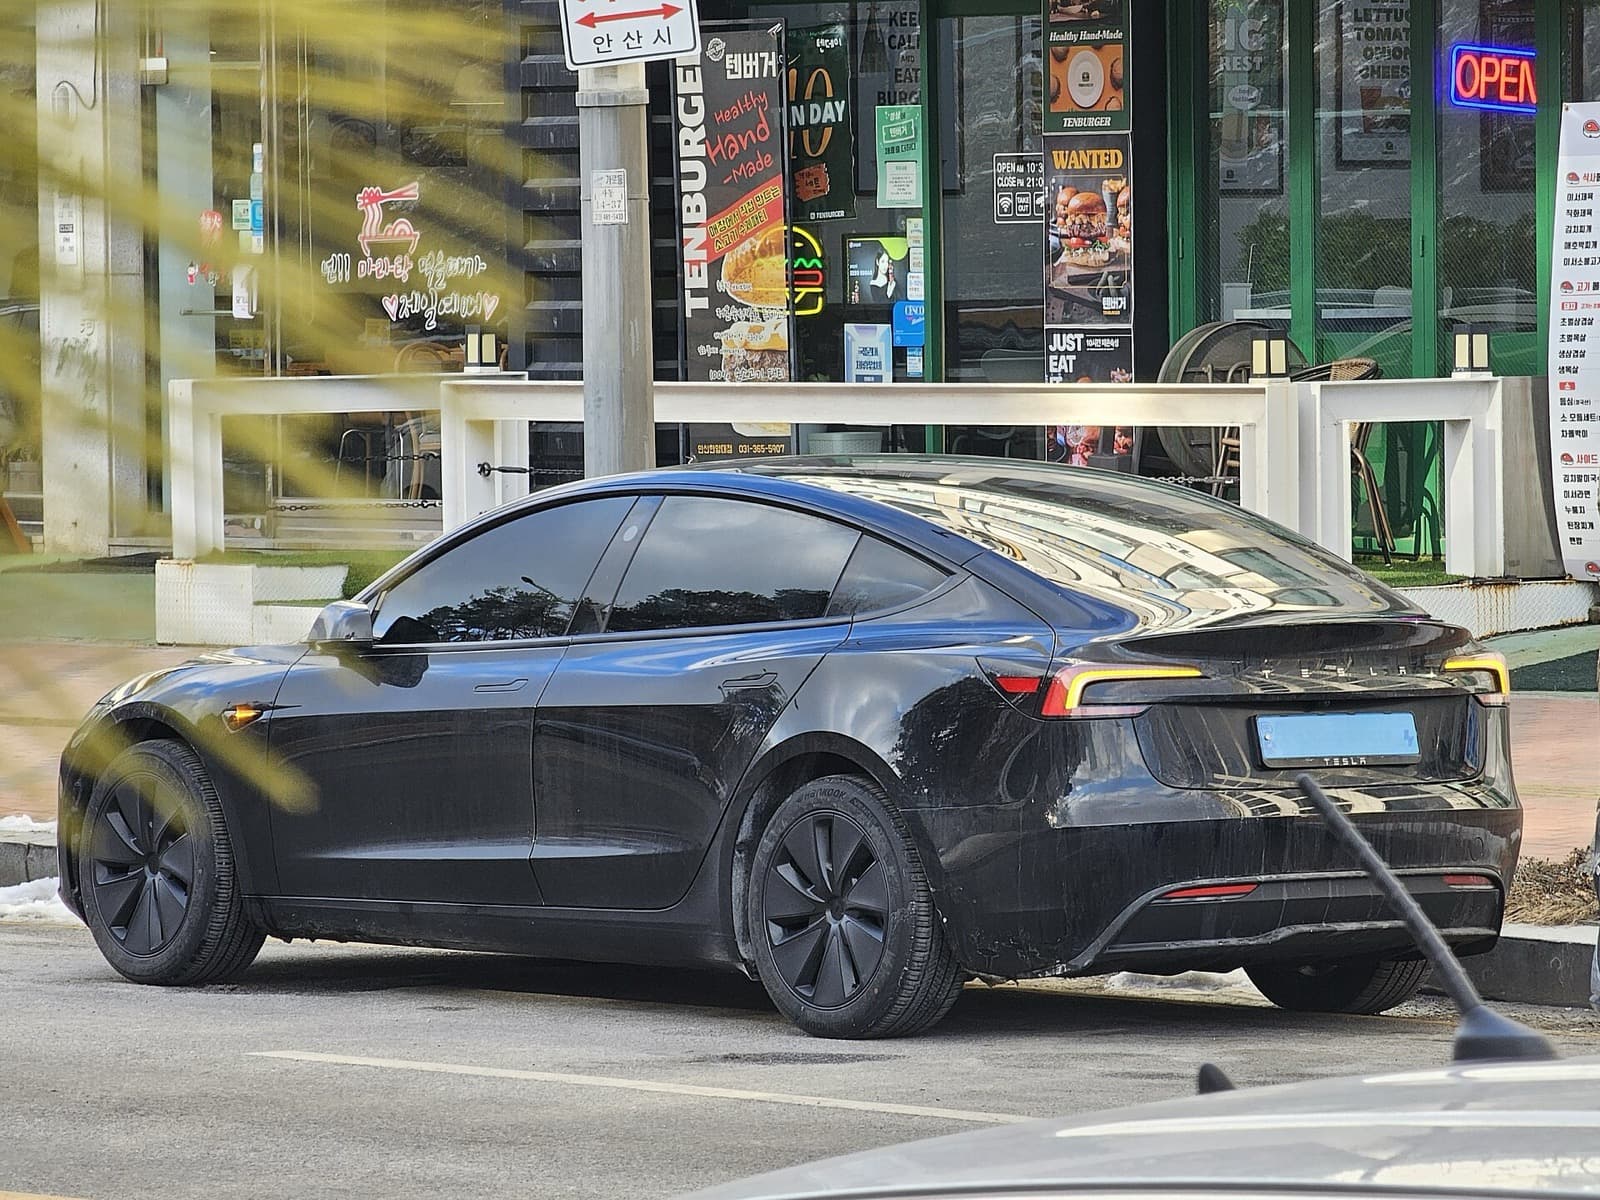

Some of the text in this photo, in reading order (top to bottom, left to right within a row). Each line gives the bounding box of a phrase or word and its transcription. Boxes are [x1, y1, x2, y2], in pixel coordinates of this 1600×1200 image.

[889, 12, 921, 27] KEE
[593, 26, 671, 54] 안산시
[1050, 30, 1123, 42] Healthy Hand-Made
[1354, 28, 1410, 41] TOMAT
[725, 51, 777, 80] 텐버거
[1359, 65, 1410, 79] CHEES
[1455, 54, 1537, 104] OPEN
[877, 91, 922, 106] BURG
[714, 90, 769, 125] Healthy
[810, 101, 846, 123] DAY
[1063, 117, 1111, 127] TENBURGER
[705, 106, 771, 167] Hand
[1052, 149, 1123, 169] WANTED
[723, 150, 774, 185] -Made
[997, 163, 1016, 173] OPEN
[1027, 163, 1043, 172] 10:3
[997, 177, 1017, 187] CLOSE
[1026, 177, 1043, 187] 21:0
[709, 211, 740, 237] 매장에서
[755, 186, 781, 206] 만드는
[358, 254, 413, 283] 마라탕
[1576, 281, 1591, 291] 고기
[1102, 296, 1127, 310] 텐버거
[1049, 333, 1084, 352] JUST
[1049, 355, 1076, 373] EAT
[1576, 454, 1599, 464] 사이드
[1563, 474, 1600, 483] 김치말이국
[1261, 666, 1408, 680] TESLA
[1323, 757, 1367, 766] TESLA
